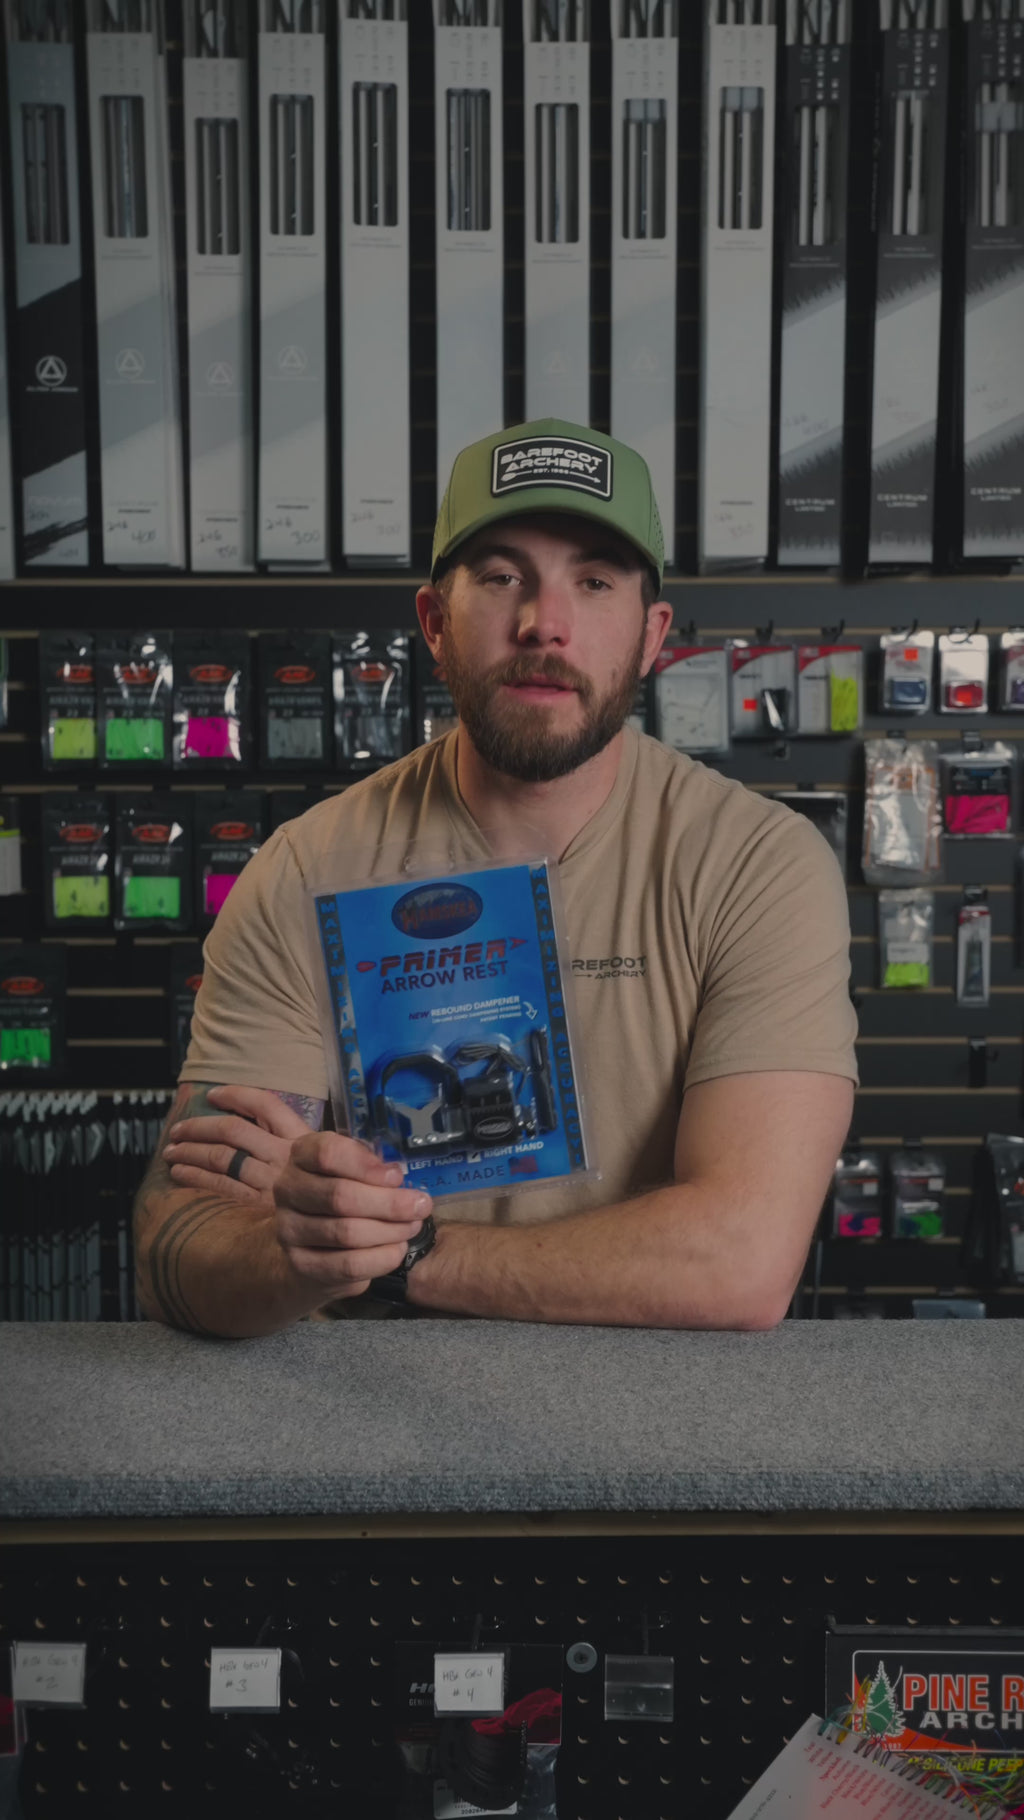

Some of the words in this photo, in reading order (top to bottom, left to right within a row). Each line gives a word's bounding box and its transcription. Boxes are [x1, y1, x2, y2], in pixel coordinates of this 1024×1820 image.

[500, 447, 603, 465] BAREFOOT
[505, 457, 597, 474] ARCHERY
[379, 938, 508, 976] PRIMER
[380, 969, 455, 995] ARROW
[463, 960, 508, 982] REST
[594, 970, 647, 980] ARCHERY
[431, 1002, 472, 1017] REBOUND
[410, 1159, 432, 1171] LEFT
[434, 1154, 463, 1167] HAND
[484, 1147, 513, 1160] RIGHT
[514, 1140, 545, 1154] HAND
[457, 1165, 505, 1184] MADE
[903, 1674, 989, 1712] PINE
